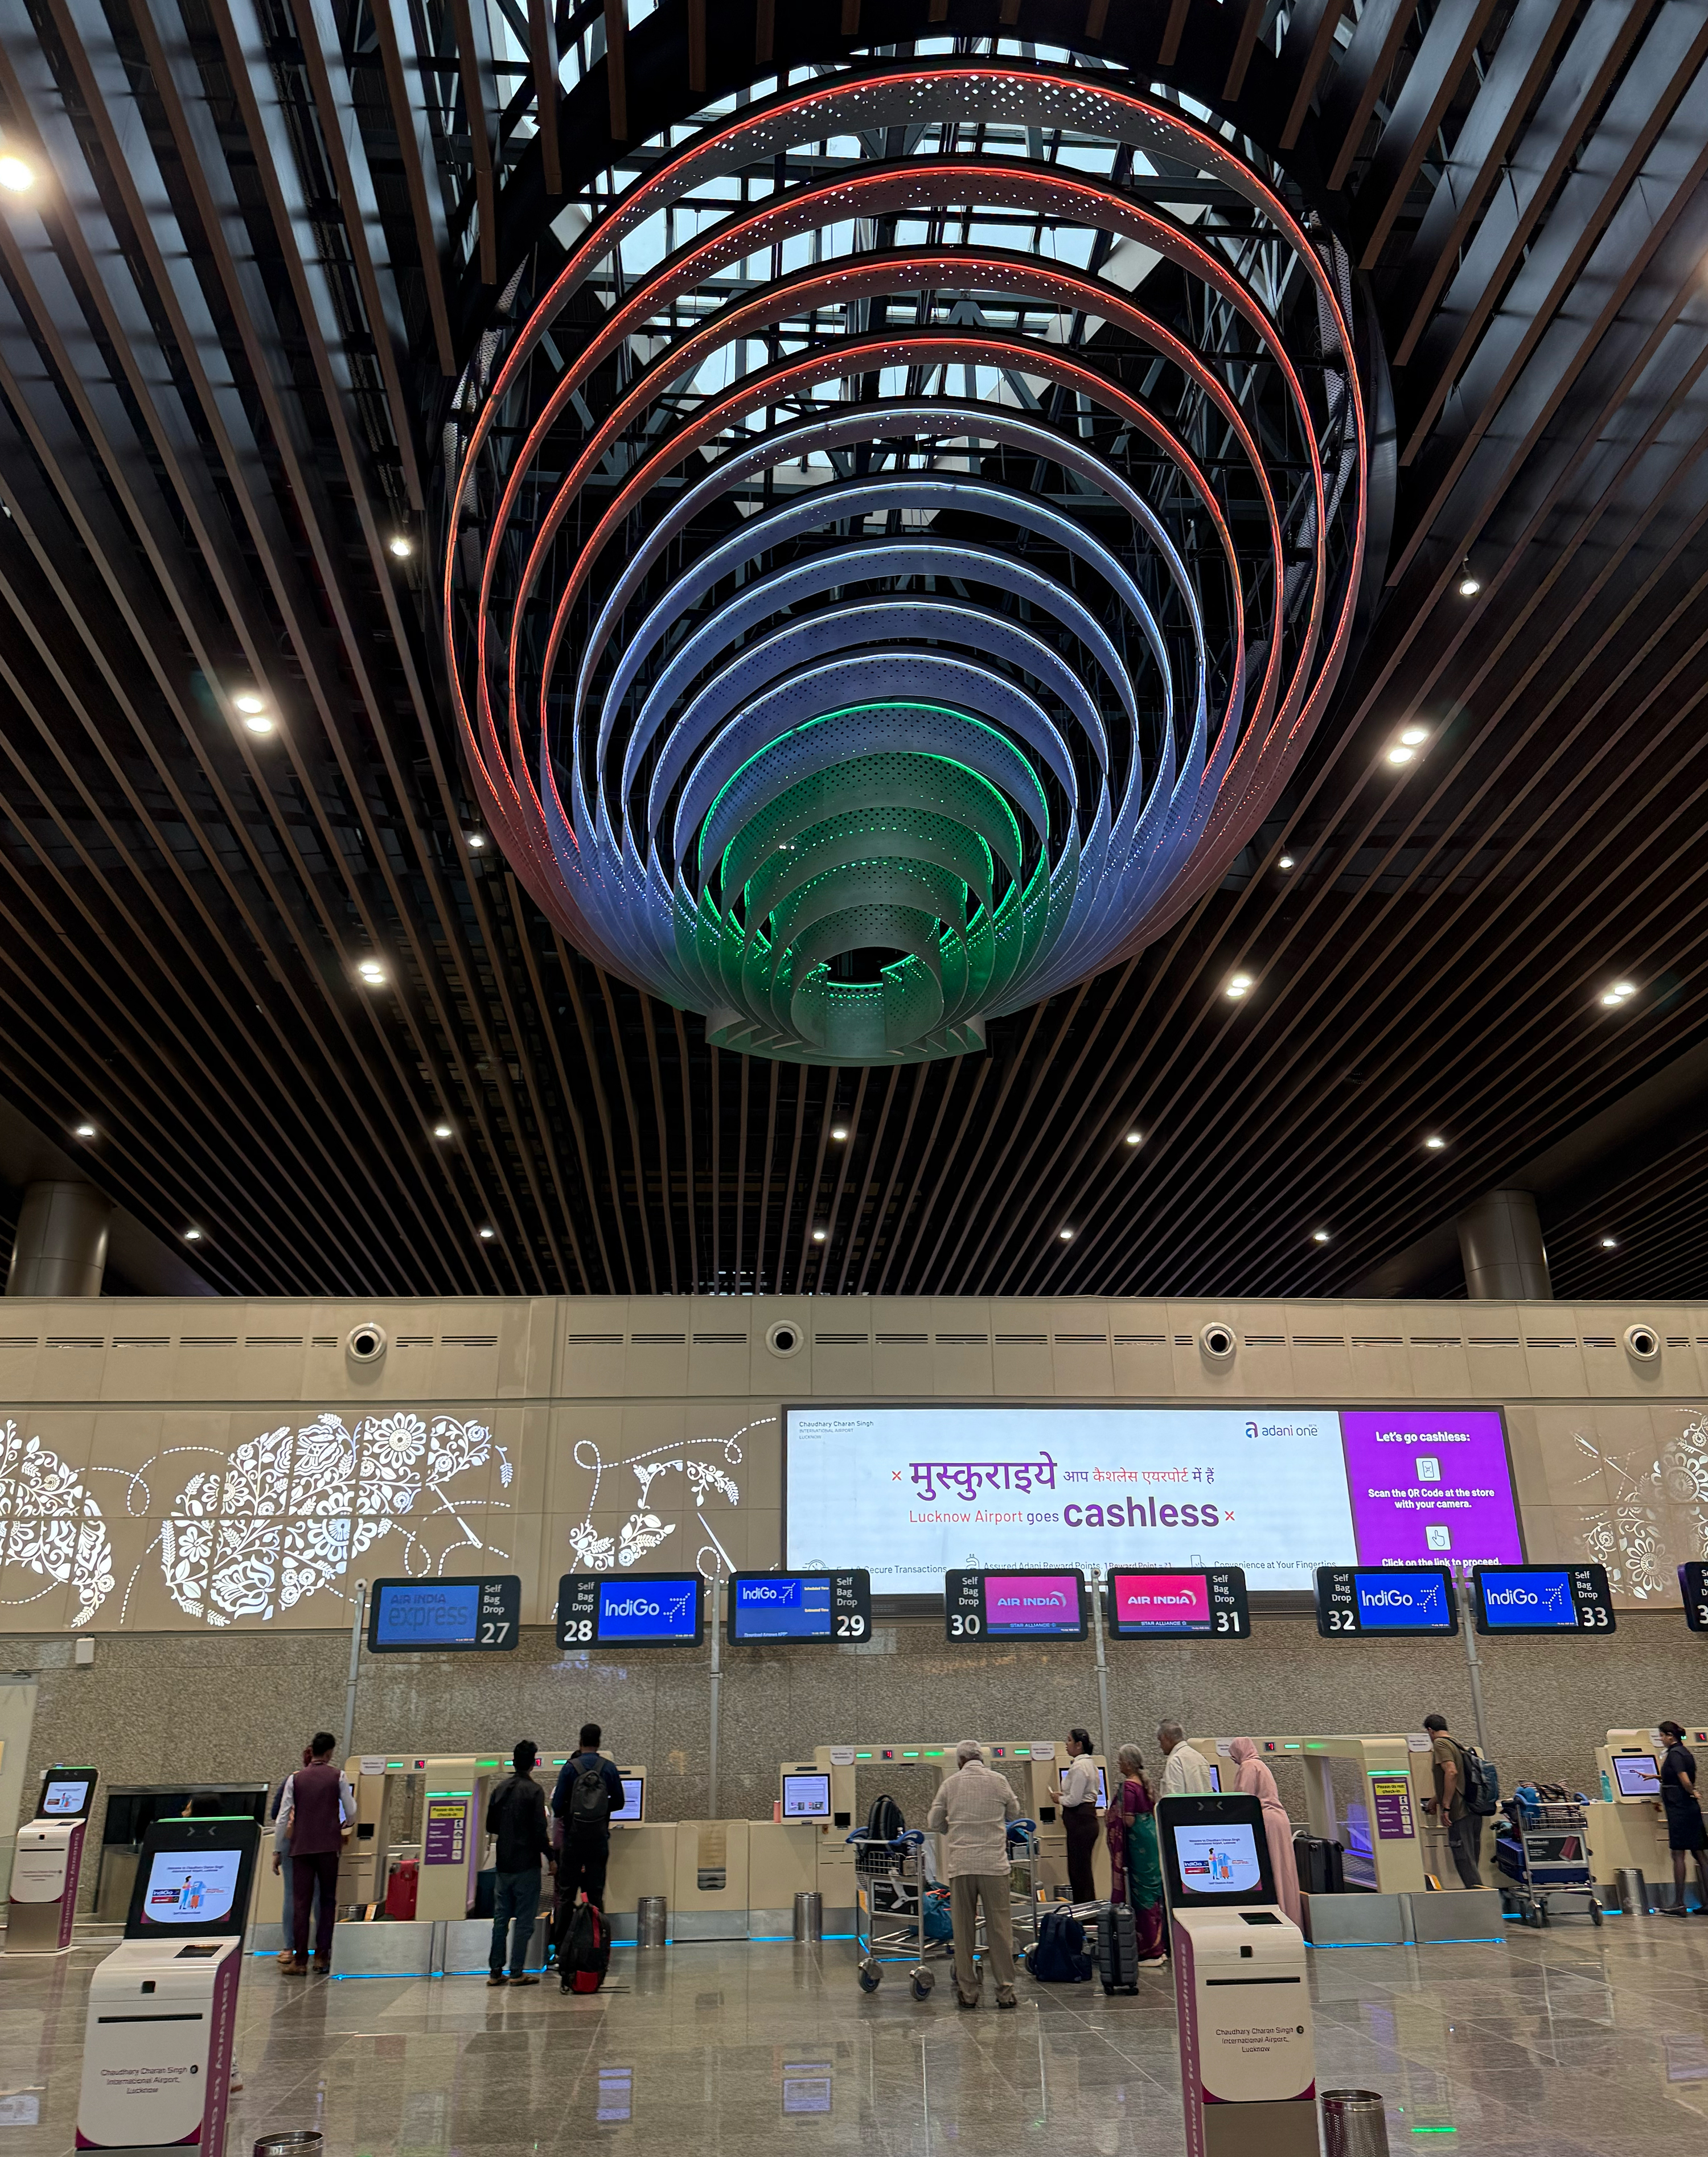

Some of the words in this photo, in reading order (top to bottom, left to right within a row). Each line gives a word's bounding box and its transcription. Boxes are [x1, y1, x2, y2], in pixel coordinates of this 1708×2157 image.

[1262, 1425, 1293, 1436] adani
[1296, 1428, 1318, 1436] one
[1376, 1431, 1402, 1442] Let's
[1403, 1433, 1418, 1444] go
[1419, 1431, 1471, 1442] cashless:
[909, 1451, 1057, 1501] मुस्कुराइये
[1063, 1471, 1089, 1482] आप
[1093, 1467, 1138, 1482] कैशलेस
[1142, 1467, 1189, 1485] एयरपोर्ट
[1192, 1468, 1202, 1482] में
[1205, 1468, 1214, 1484] हैं
[1368, 1489, 1390, 1498] Scan
[1391, 1489, 1406, 1497] the
[1407, 1489, 1420, 1498] QR
[1421, 1489, 1444, 1497] Code
[1455, 1488, 1471, 1497] the
[1394, 1499, 1415, 1509] with
[1415, 1501, 1435, 1510] your
[910, 1510, 971, 1523] Lucknow
[975, 1509, 1023, 1526] Airport
[1027, 1510, 1060, 1526] goes
[1064, 1496, 1220, 1527] cashless
[1276, 1560, 1294, 1569] Your
[1296, 1560, 1336, 1570] Fingertips
[1434, 1558, 1450, 1566] link
[1463, 1557, 1502, 1568] proceed.
[894, 1564, 947, 1573] Transactions
[1212, 1574, 1229, 1583] Self
[1333, 1573, 1349, 1582] Self
[1575, 1571, 1590, 1579] Self
[836, 1577, 853, 1585] Self
[962, 1576, 979, 1585] Self
[485, 1584, 502, 1593] Self
[577, 1581, 595, 1591] Self
[1213, 1585, 1229, 1595] Bag
[1335, 1584, 1350, 1593] Bag
[1576, 1581, 1592, 1591] Bag
[742, 1587, 777, 1600] IndiGo
[836, 1588, 853, 1597] Bag
[963, 1587, 979, 1597] Bag
[1487, 1588, 1538, 1605] IndiGo
[1578, 1591, 1598, 1600] Drop
[391, 1594, 410, 1604] AIR
[413, 1593, 446, 1604] INDIA
[483, 1595, 500, 1605] Bag
[577, 1592, 594, 1603] Bag
[958, 1597, 979, 1607] Drop
[1023, 1597, 1060, 1606] INDIA
[1153, 1596, 1190, 1604] INDIA
[1214, 1595, 1235, 1604] Drop
[1331, 1594, 1352, 1604] Drop
[1361, 1589, 1413, 1607] IndiGo
[572, 1603, 594, 1612] Drop
[605, 1598, 659, 1617] IndiGo
[836, 1598, 857, 1608] Drop
[483, 1605, 505, 1616] Drop
[388, 1606, 467, 1631] express
[1216, 1611, 1240, 1632] 31
[1328, 1610, 1356, 1630] 32
[1582, 1607, 1608, 1628] 33
[837, 1614, 865, 1636] 29
[951, 1614, 980, 1636] 30
[481, 1622, 510, 1644] 27
[564, 1620, 593, 1642] 28
